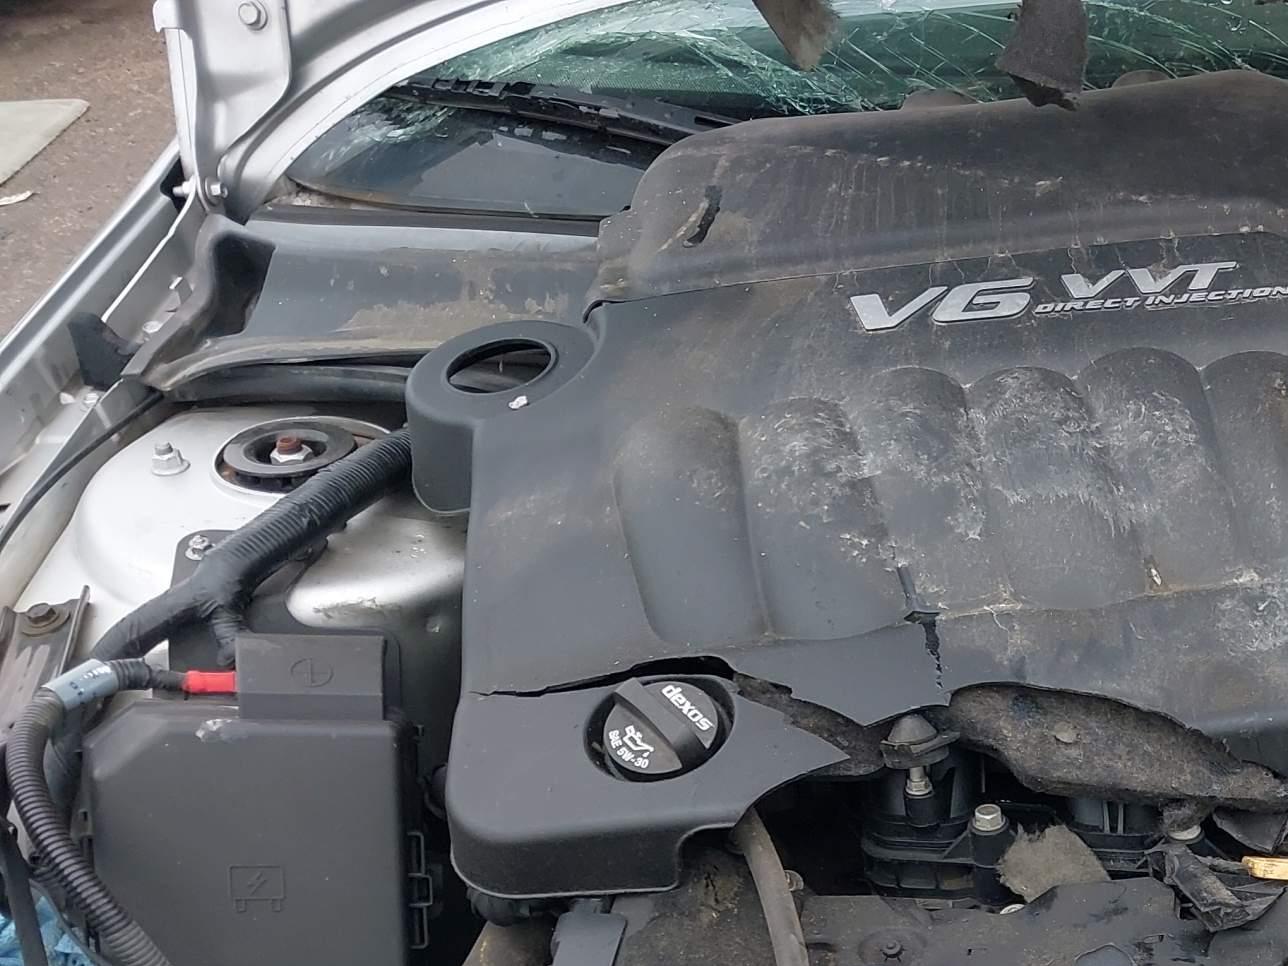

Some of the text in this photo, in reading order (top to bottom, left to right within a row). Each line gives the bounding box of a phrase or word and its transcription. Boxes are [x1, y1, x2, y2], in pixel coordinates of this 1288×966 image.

[849, 261, 1240, 331] V6 VVT
[1034, 296, 1143, 314] DIRECT
[661, 685, 715, 731] dexos
[617, 748, 649, 768] 5W-30
